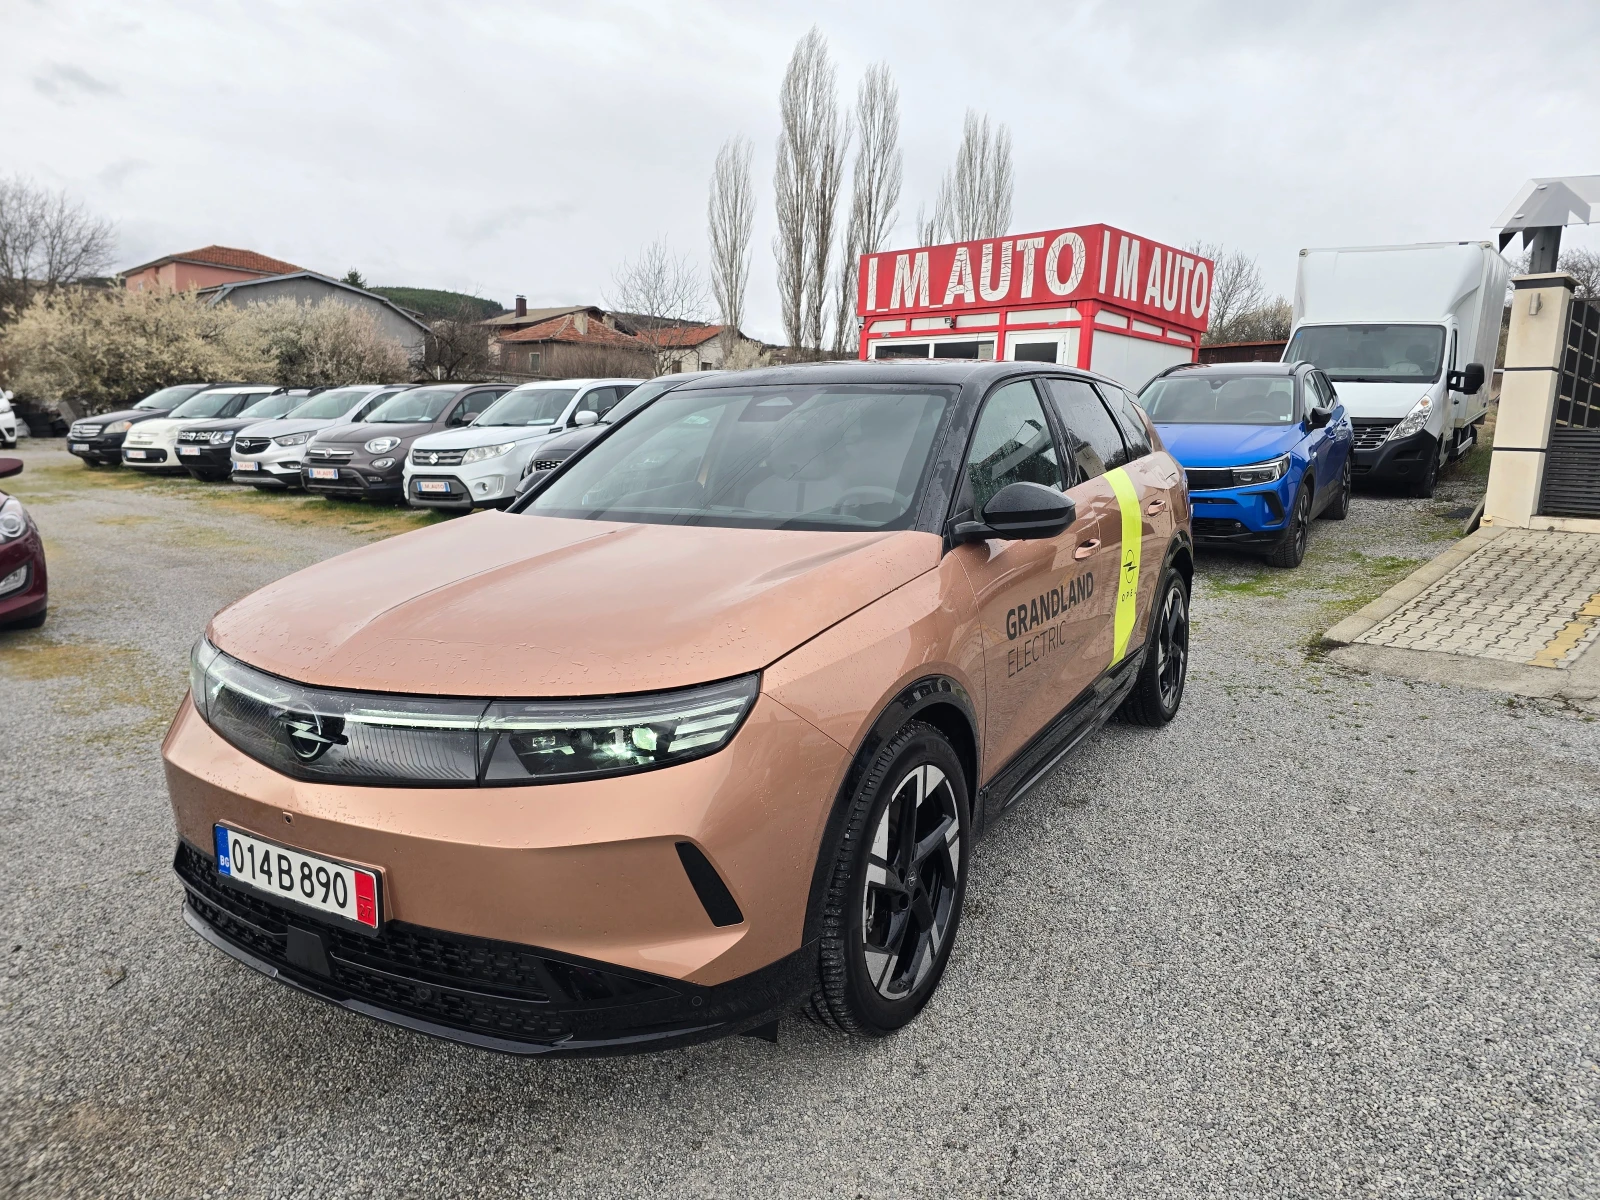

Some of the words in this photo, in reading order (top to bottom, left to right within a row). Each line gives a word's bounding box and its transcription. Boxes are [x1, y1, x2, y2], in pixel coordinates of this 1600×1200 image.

[1099, 230, 1111, 294] I
[1113, 235, 1140, 302] M
[1143, 246, 1209, 319] AUTO
[1006, 572, 1094, 641] GRANDLAND
[1008, 620, 1067, 678] ELECTRIC
[220, 854, 230, 868] BG
[359, 904, 372, 919] 27
